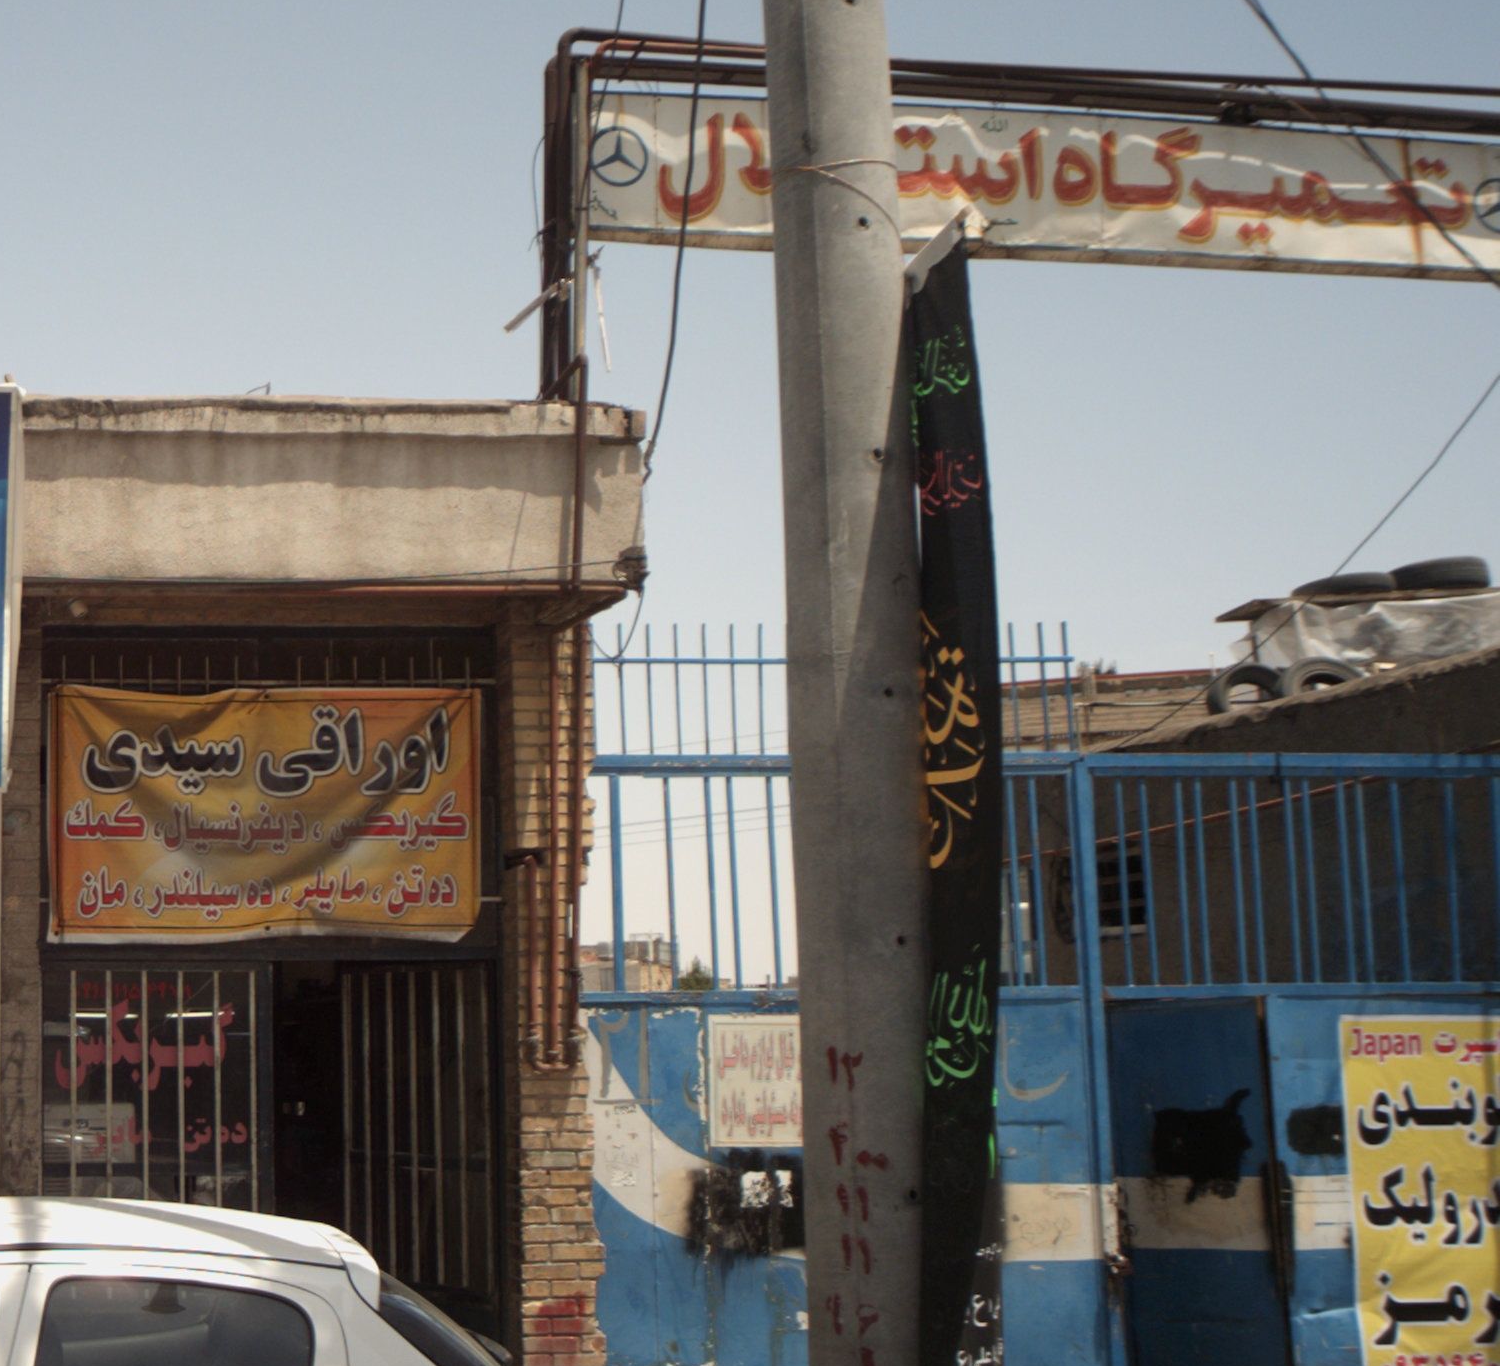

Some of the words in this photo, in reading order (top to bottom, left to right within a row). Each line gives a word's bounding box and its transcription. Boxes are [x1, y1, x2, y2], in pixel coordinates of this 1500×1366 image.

[658, 111, 1046, 223] استال
[81, 723, 245, 794] سیدی
[1351, 1028, 1421, 1062] Japan
[1358, 1082, 1500, 1145] وبندی
[1374, 1272, 1500, 1344] رمز
